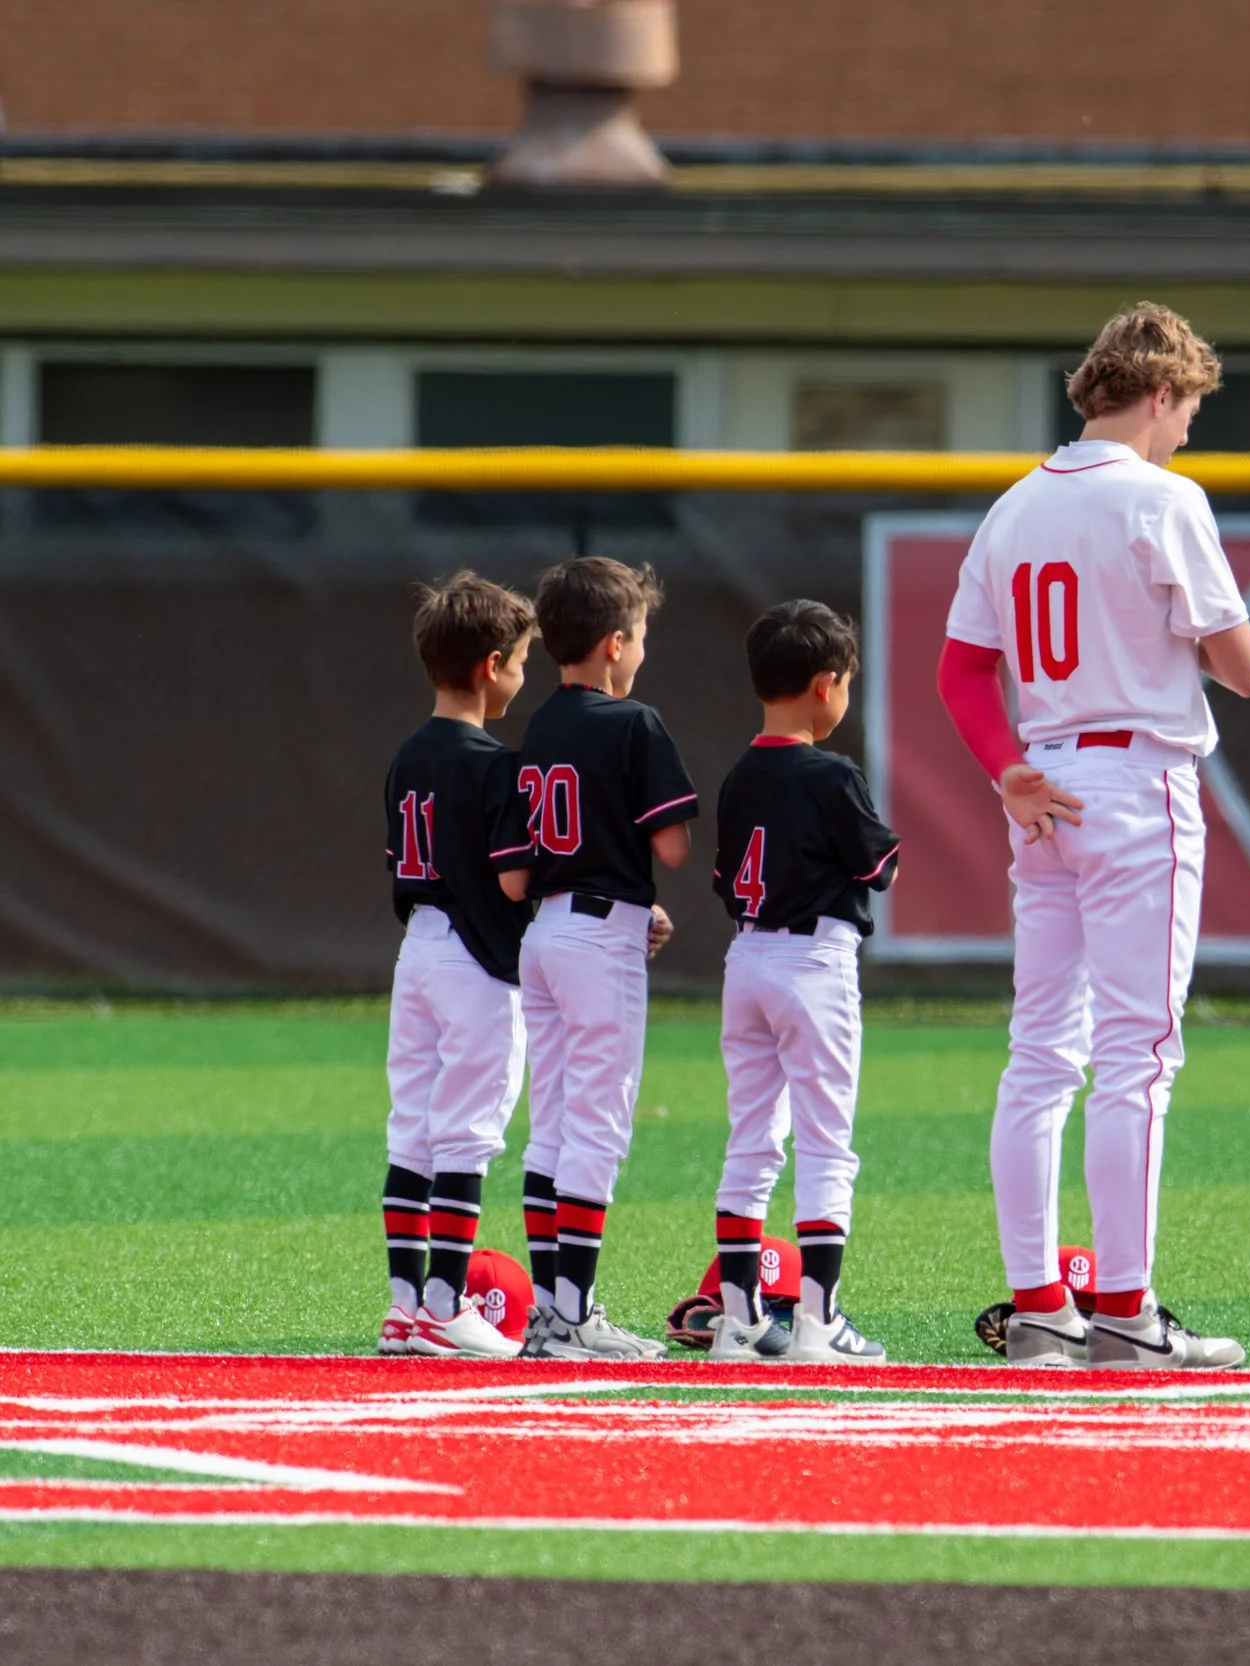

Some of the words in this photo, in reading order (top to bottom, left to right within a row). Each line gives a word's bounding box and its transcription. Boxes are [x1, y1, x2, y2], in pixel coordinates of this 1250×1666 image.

[1012, 562, 1079, 682] 10
[397, 790, 441, 880] 11
[518, 764, 582, 856] 20
[733, 826, 765, 917] 4
[837, 1329, 866, 1353] N
